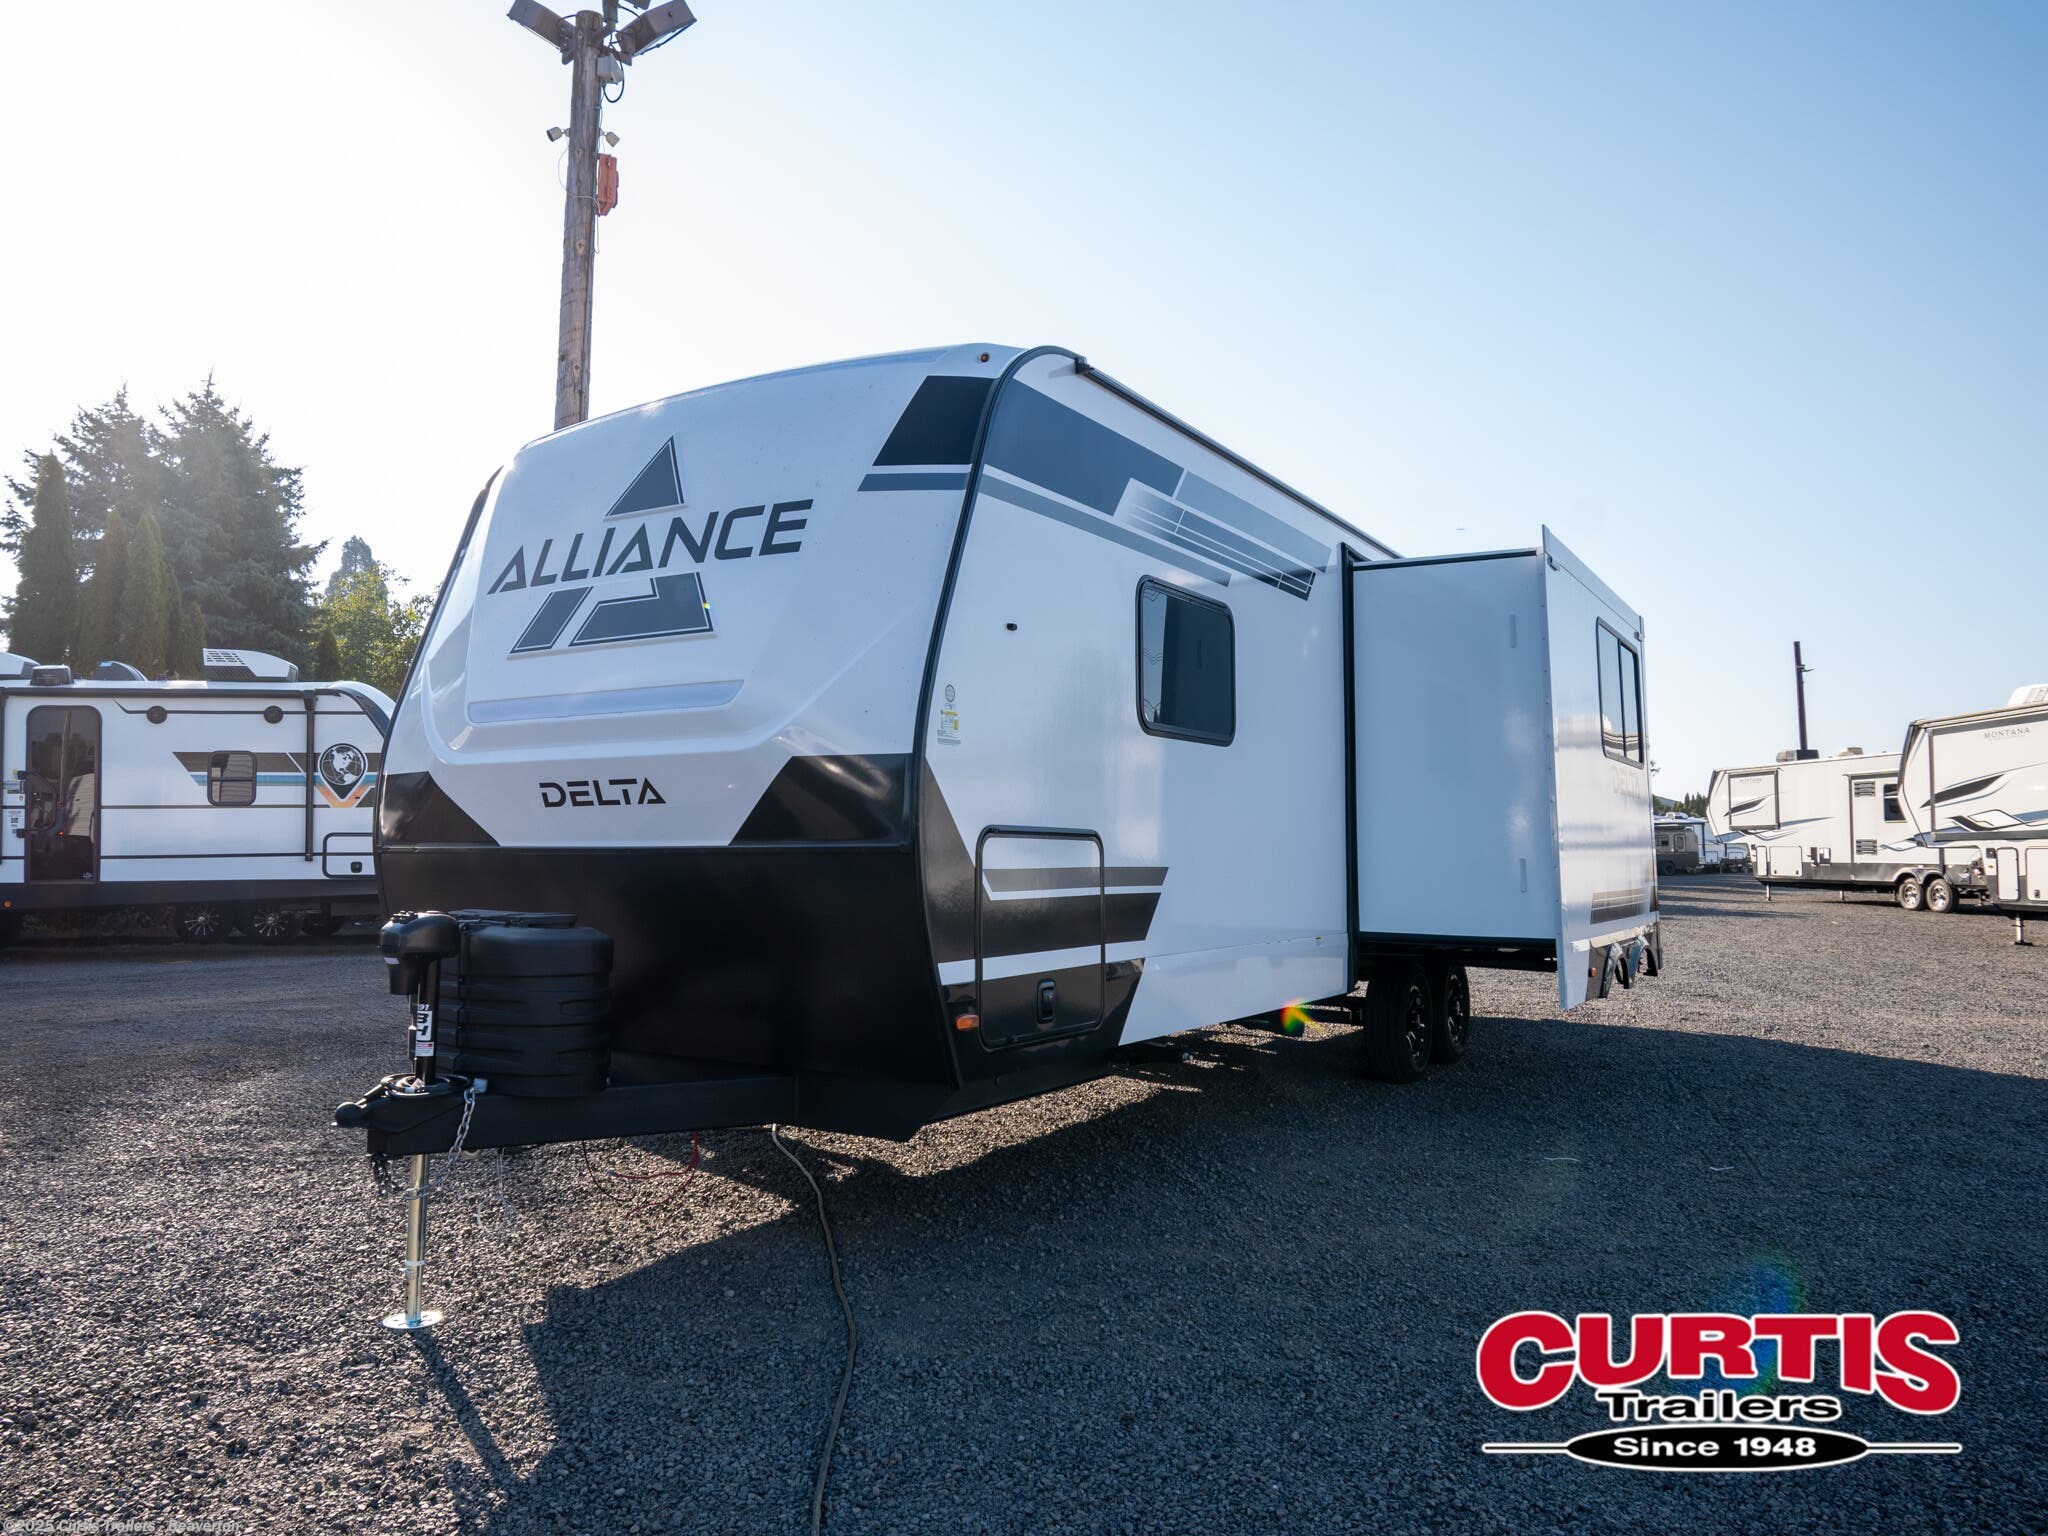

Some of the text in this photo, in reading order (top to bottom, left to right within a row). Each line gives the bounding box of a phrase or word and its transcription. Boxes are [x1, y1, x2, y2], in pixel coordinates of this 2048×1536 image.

[487, 498, 814, 595] ALLIANCE
[1984, 727, 2031, 738] MONTANA
[539, 777, 667, 808] DELTA
